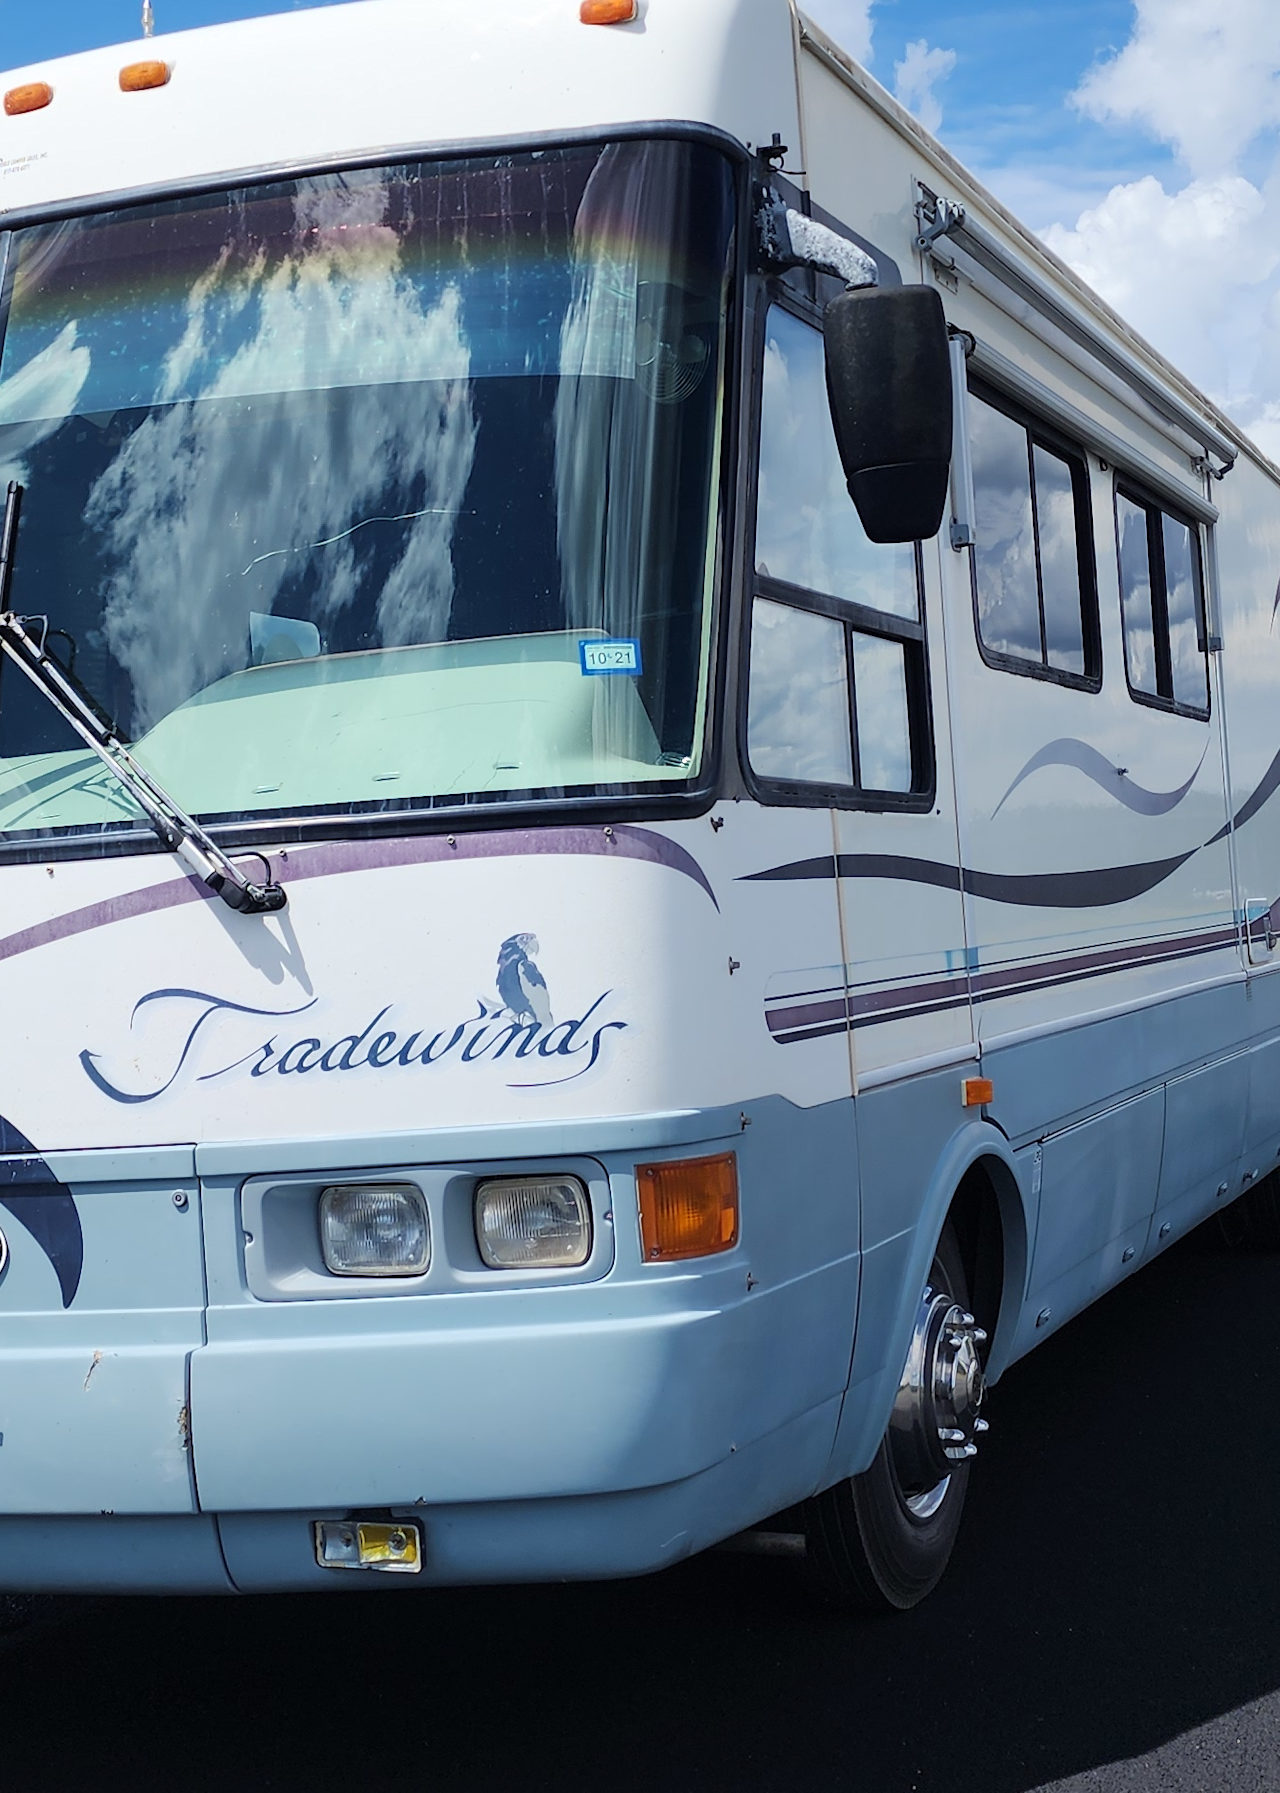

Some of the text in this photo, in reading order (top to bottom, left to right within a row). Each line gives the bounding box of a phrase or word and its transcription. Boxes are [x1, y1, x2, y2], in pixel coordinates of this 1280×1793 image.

[588, 651, 632, 665] 10 21
[79, 988, 628, 1104] Tradewinds
